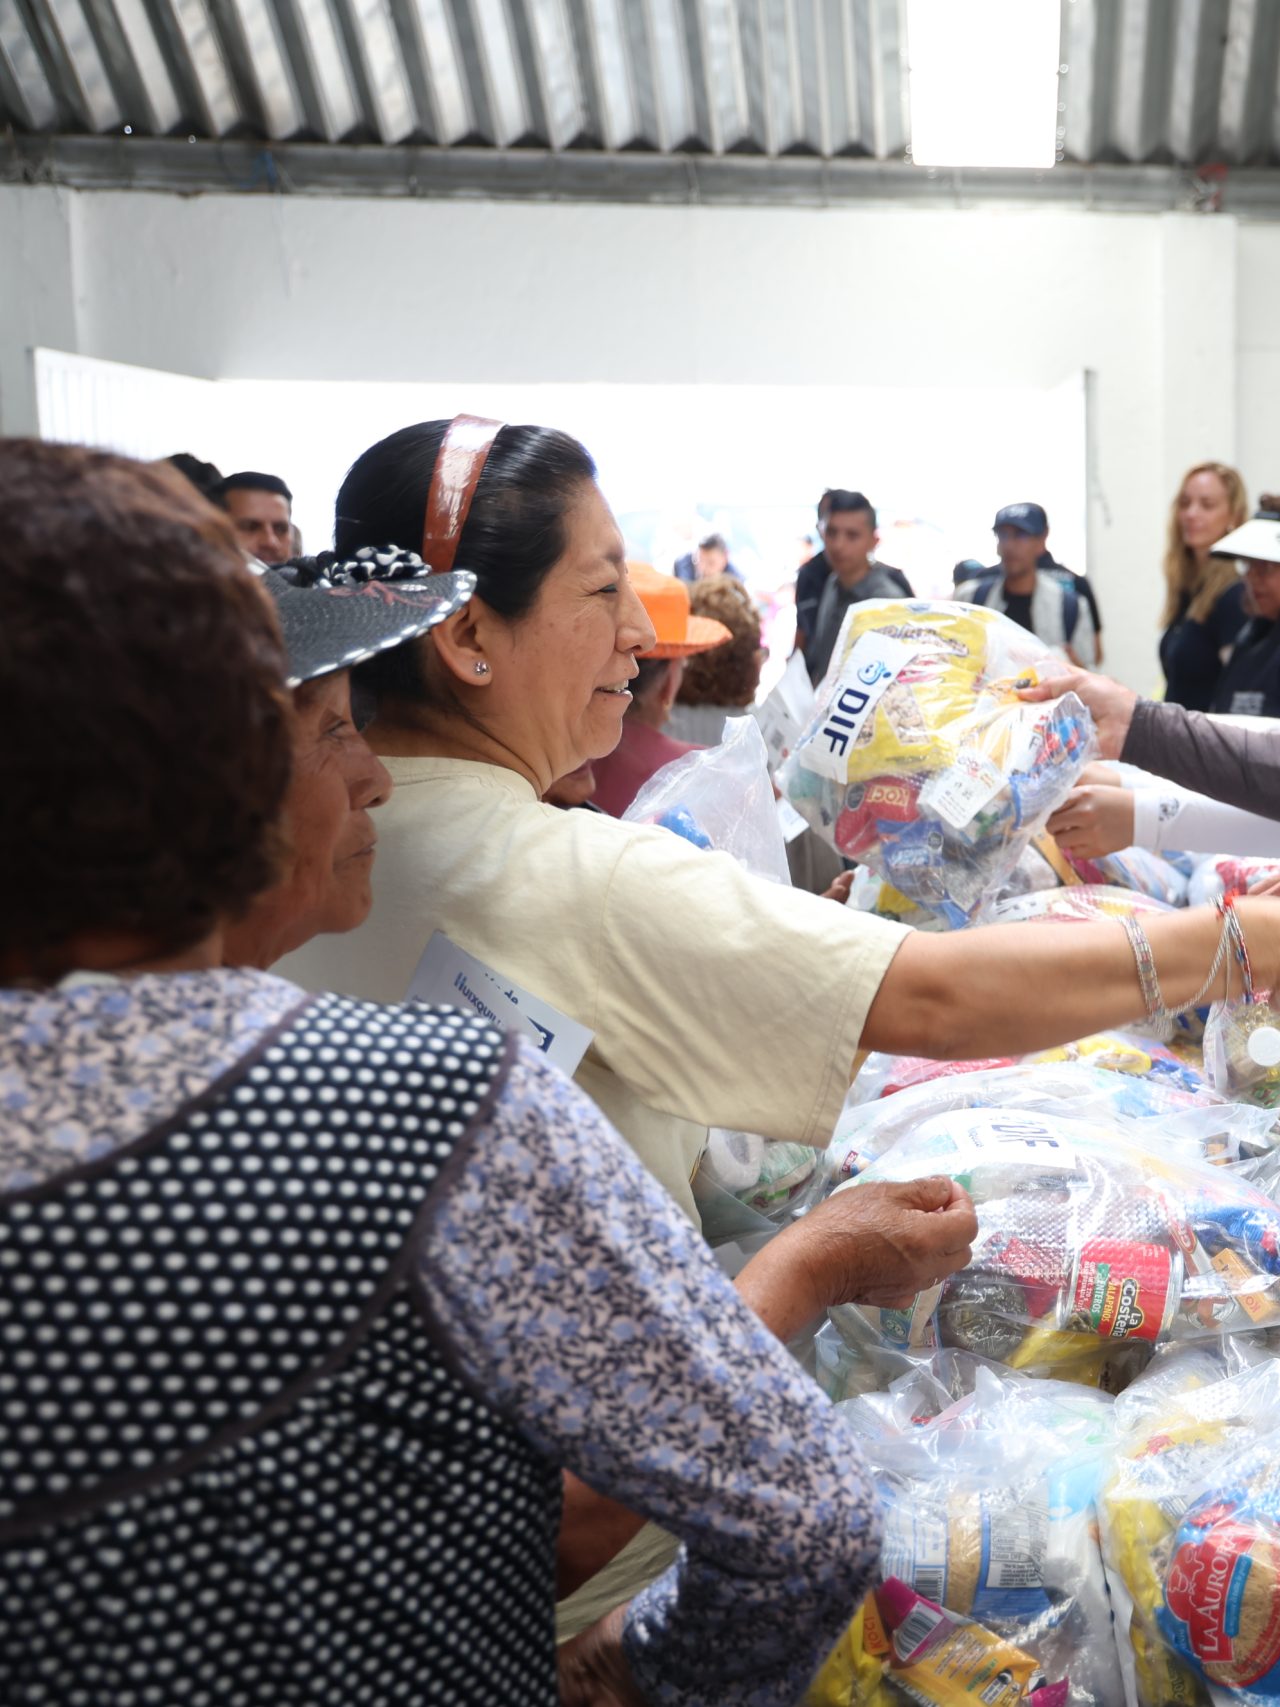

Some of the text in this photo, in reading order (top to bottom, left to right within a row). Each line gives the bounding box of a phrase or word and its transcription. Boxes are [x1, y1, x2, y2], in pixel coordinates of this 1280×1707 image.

[823, 688, 870, 757] DIF
[1112, 1283, 1136, 1338] Costeña
[1129, 1312, 1141, 1325] La
